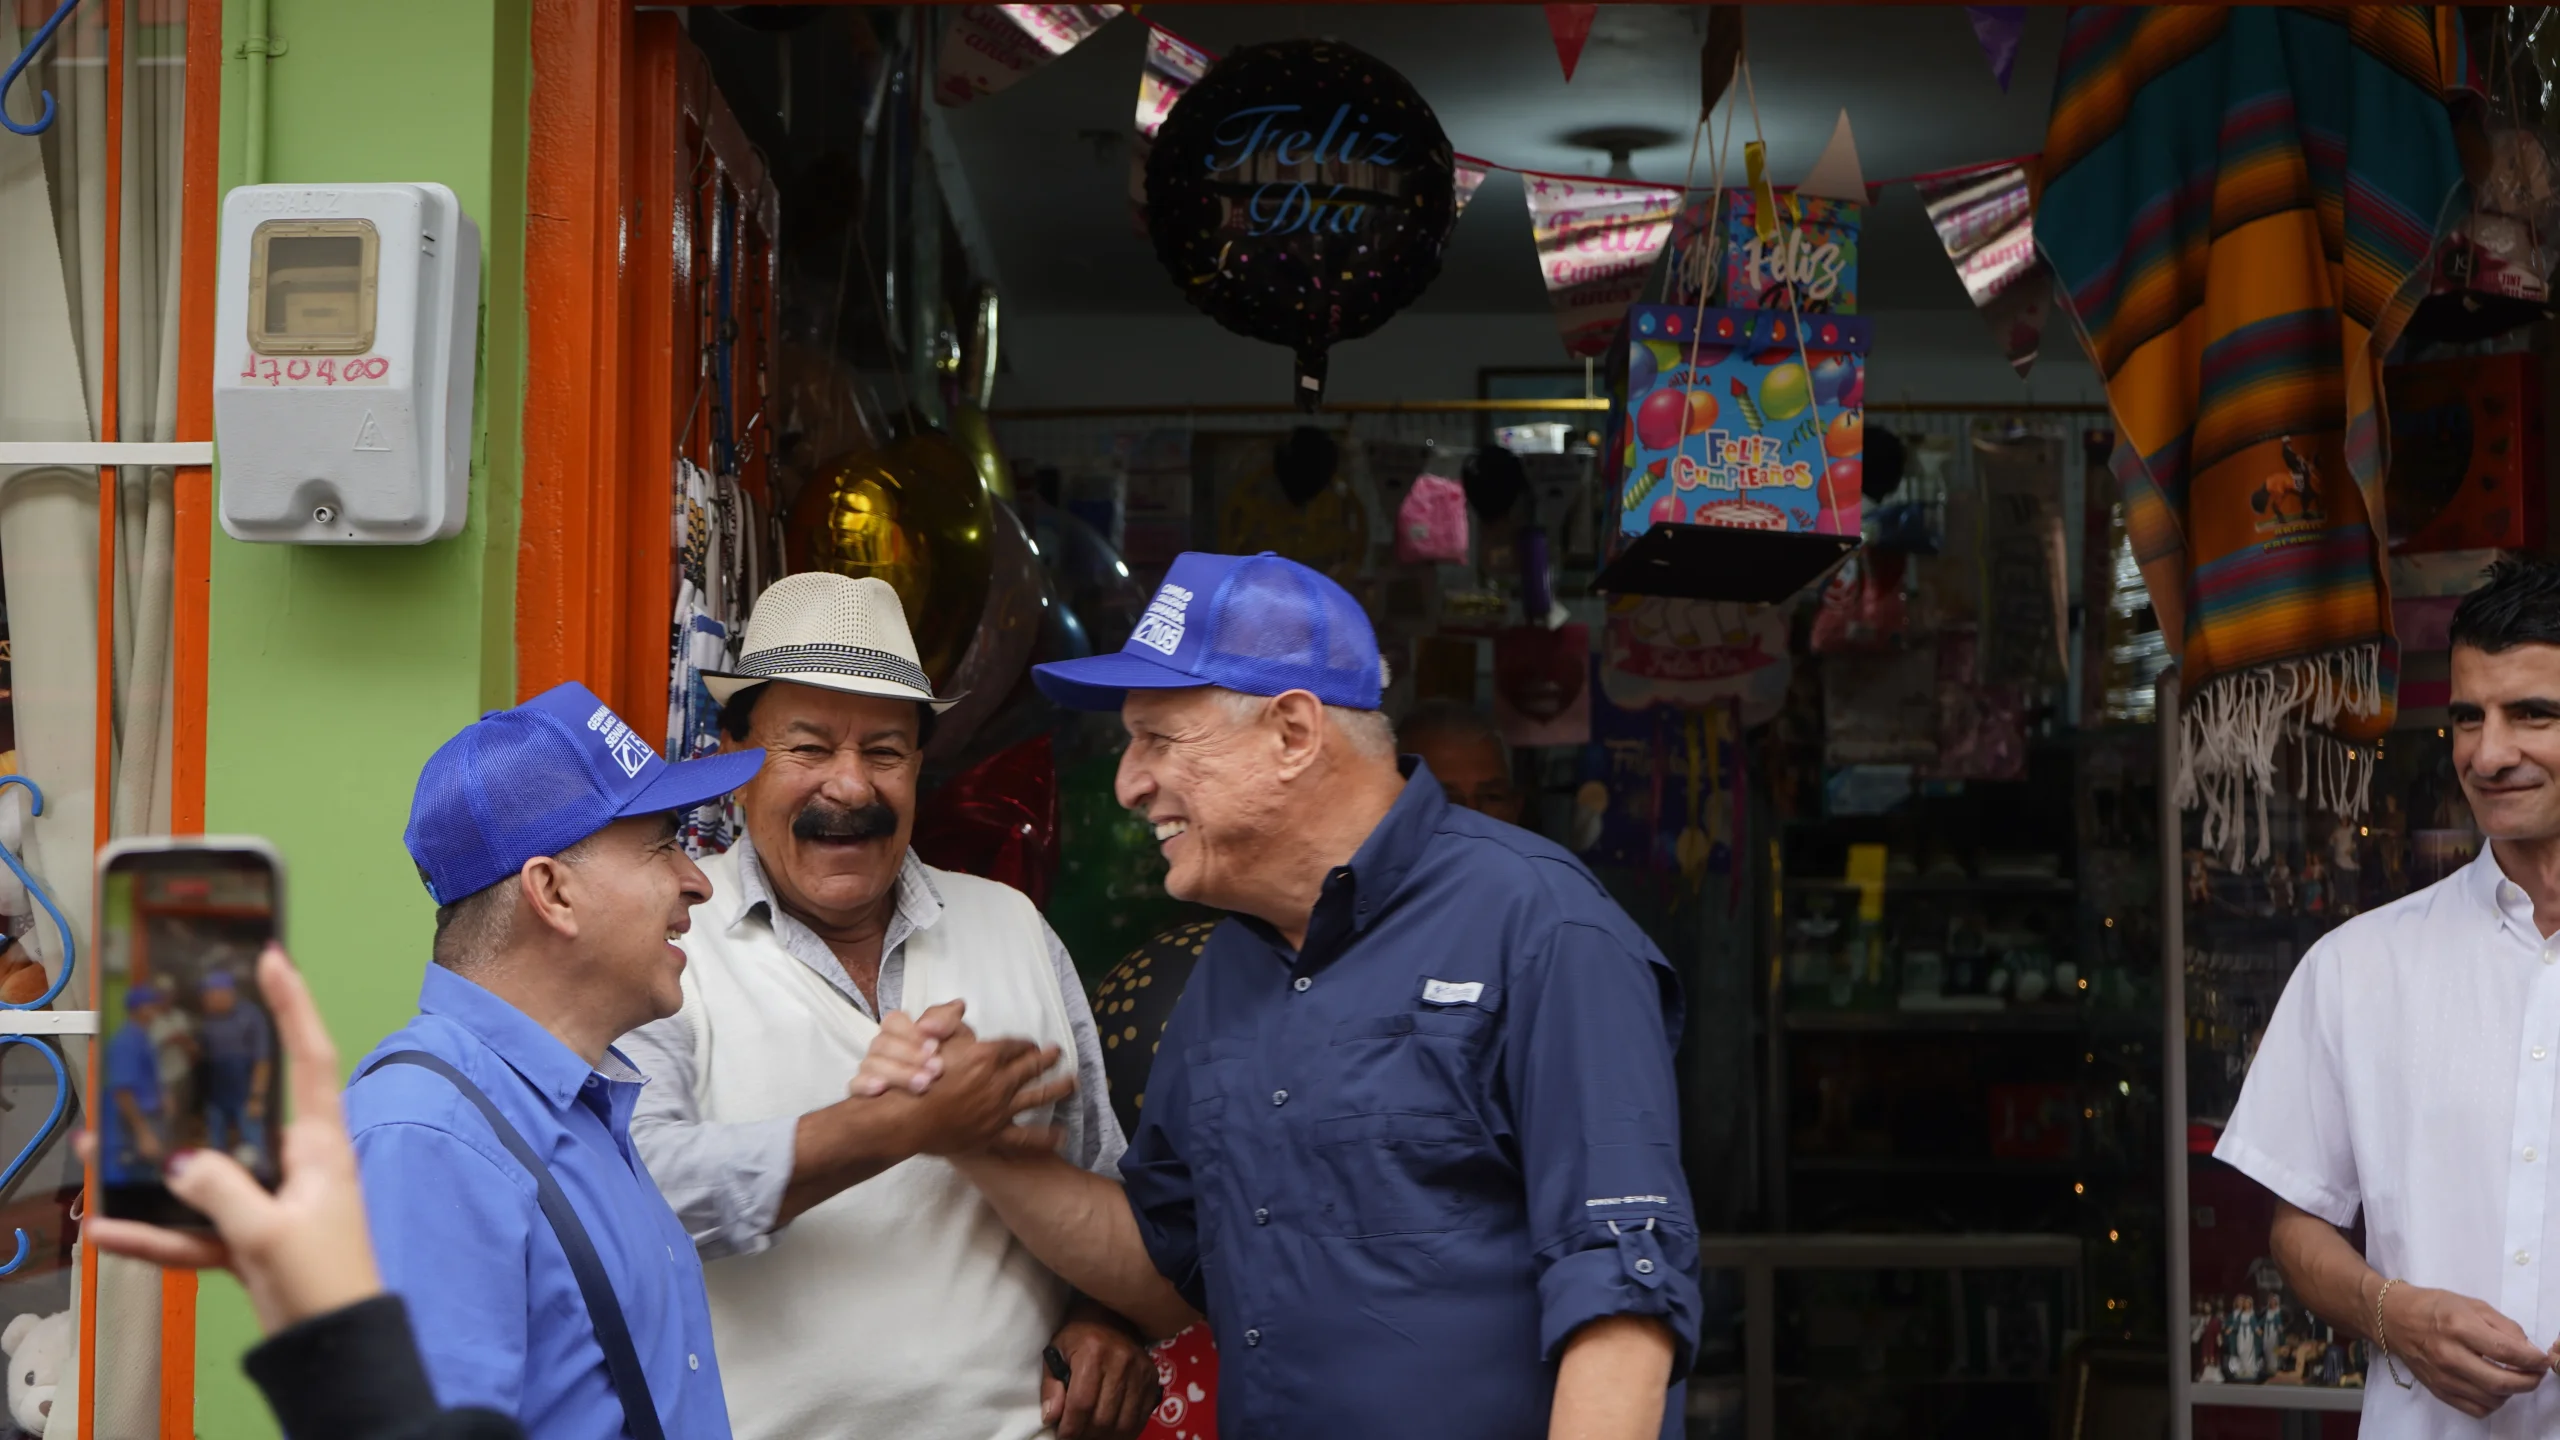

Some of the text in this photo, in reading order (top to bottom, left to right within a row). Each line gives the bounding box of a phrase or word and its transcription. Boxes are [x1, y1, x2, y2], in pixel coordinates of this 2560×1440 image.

[1203, 102, 1406, 172] Feliz
[1247, 181, 1366, 237] Día
[1548, 210, 1657, 253] Feliz
[1742, 227, 1846, 300] Feliz
